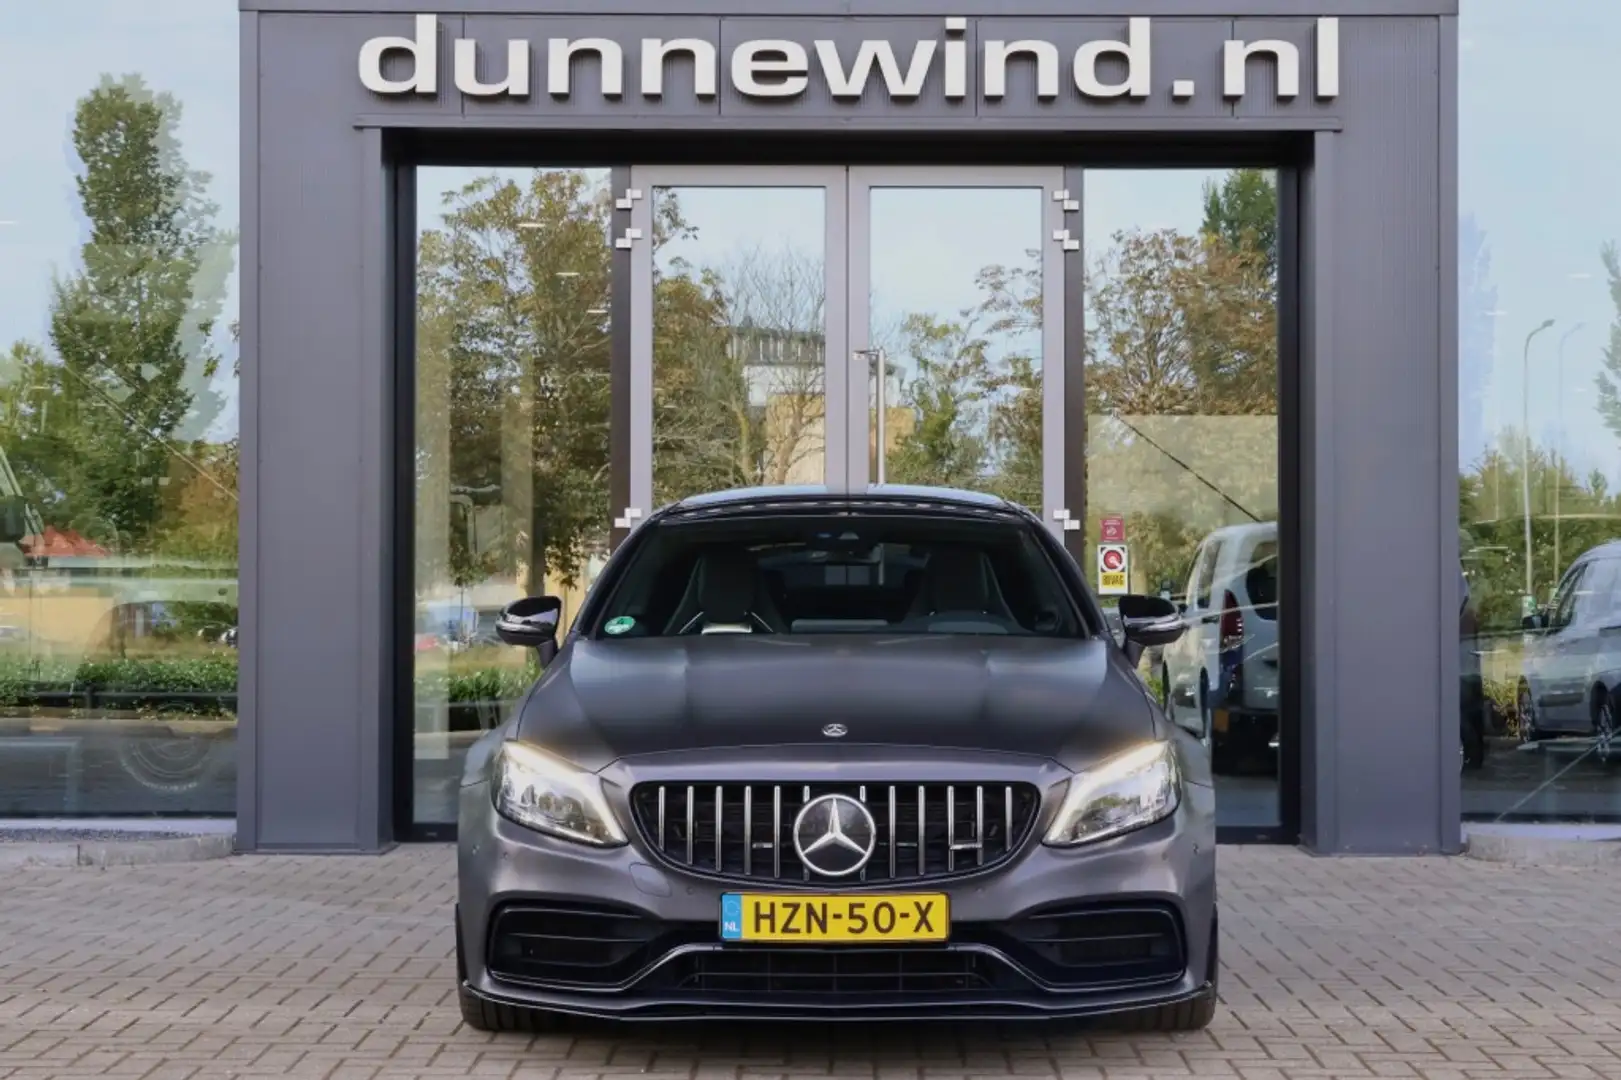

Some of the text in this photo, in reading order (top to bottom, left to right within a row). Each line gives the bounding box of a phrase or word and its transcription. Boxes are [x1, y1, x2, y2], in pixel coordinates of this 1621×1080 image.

[357, 14, 1339, 99] dunnewind.nl
[724, 921, 740, 932] NL
[754, 901, 934, 934] HZN-50-X
